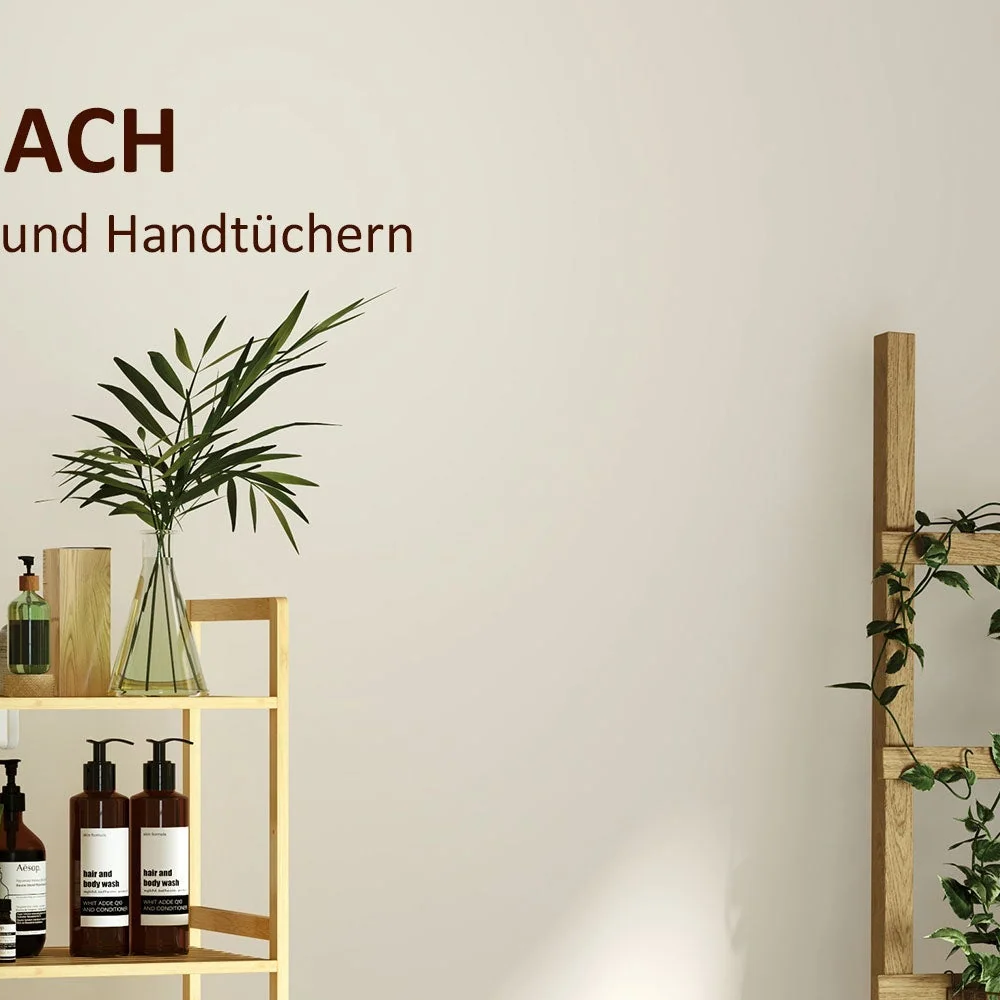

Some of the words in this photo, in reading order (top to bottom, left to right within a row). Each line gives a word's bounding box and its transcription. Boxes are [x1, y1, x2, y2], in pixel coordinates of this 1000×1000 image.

[83, 880, 100, 888] body
[143, 879, 160, 888] body
[161, 879, 179, 887] wash
